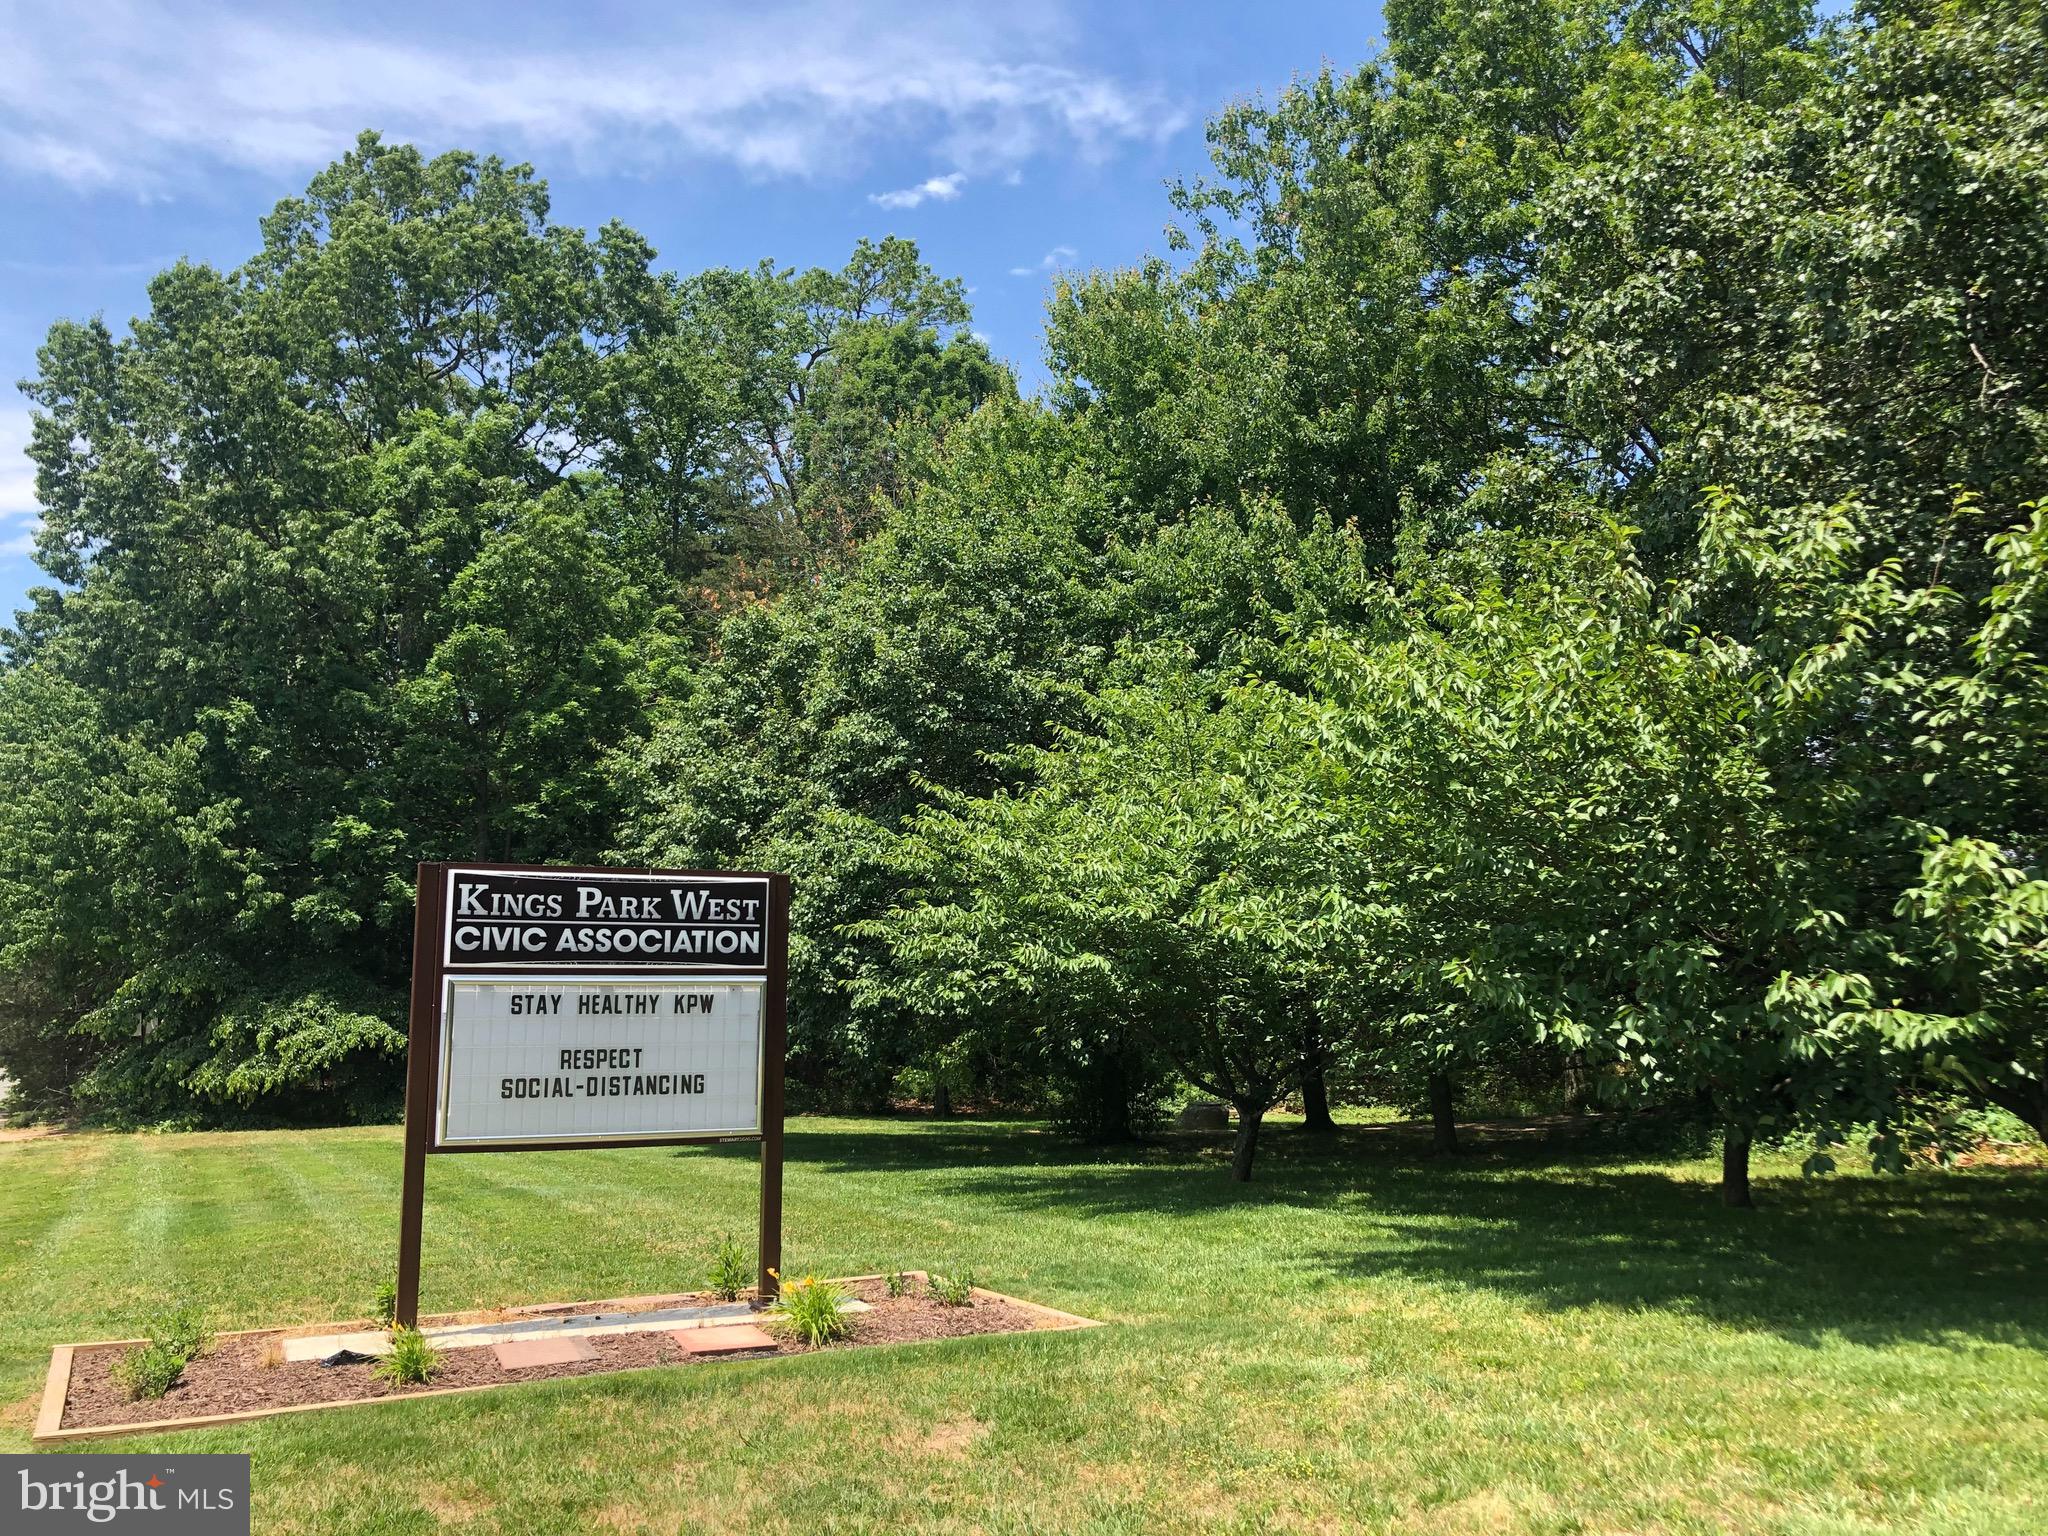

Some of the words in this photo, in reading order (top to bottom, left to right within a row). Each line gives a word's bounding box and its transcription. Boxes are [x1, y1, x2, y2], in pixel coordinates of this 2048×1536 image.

[457, 883, 563, 918] KINGS
[575, 886, 662, 920] PARK
[670, 889, 760, 921] WEST
[454, 925, 548, 951] CIVIC
[555, 928, 760, 954] ASSOCIATION
[511, 994, 562, 1015] STAY
[578, 994, 659, 1015] HEALTHY
[674, 994, 714, 1014] KPW
[560, 1048, 643, 1070] RESPECT
[501, 1074, 705, 1099] SOCIAL-DISTANCING
